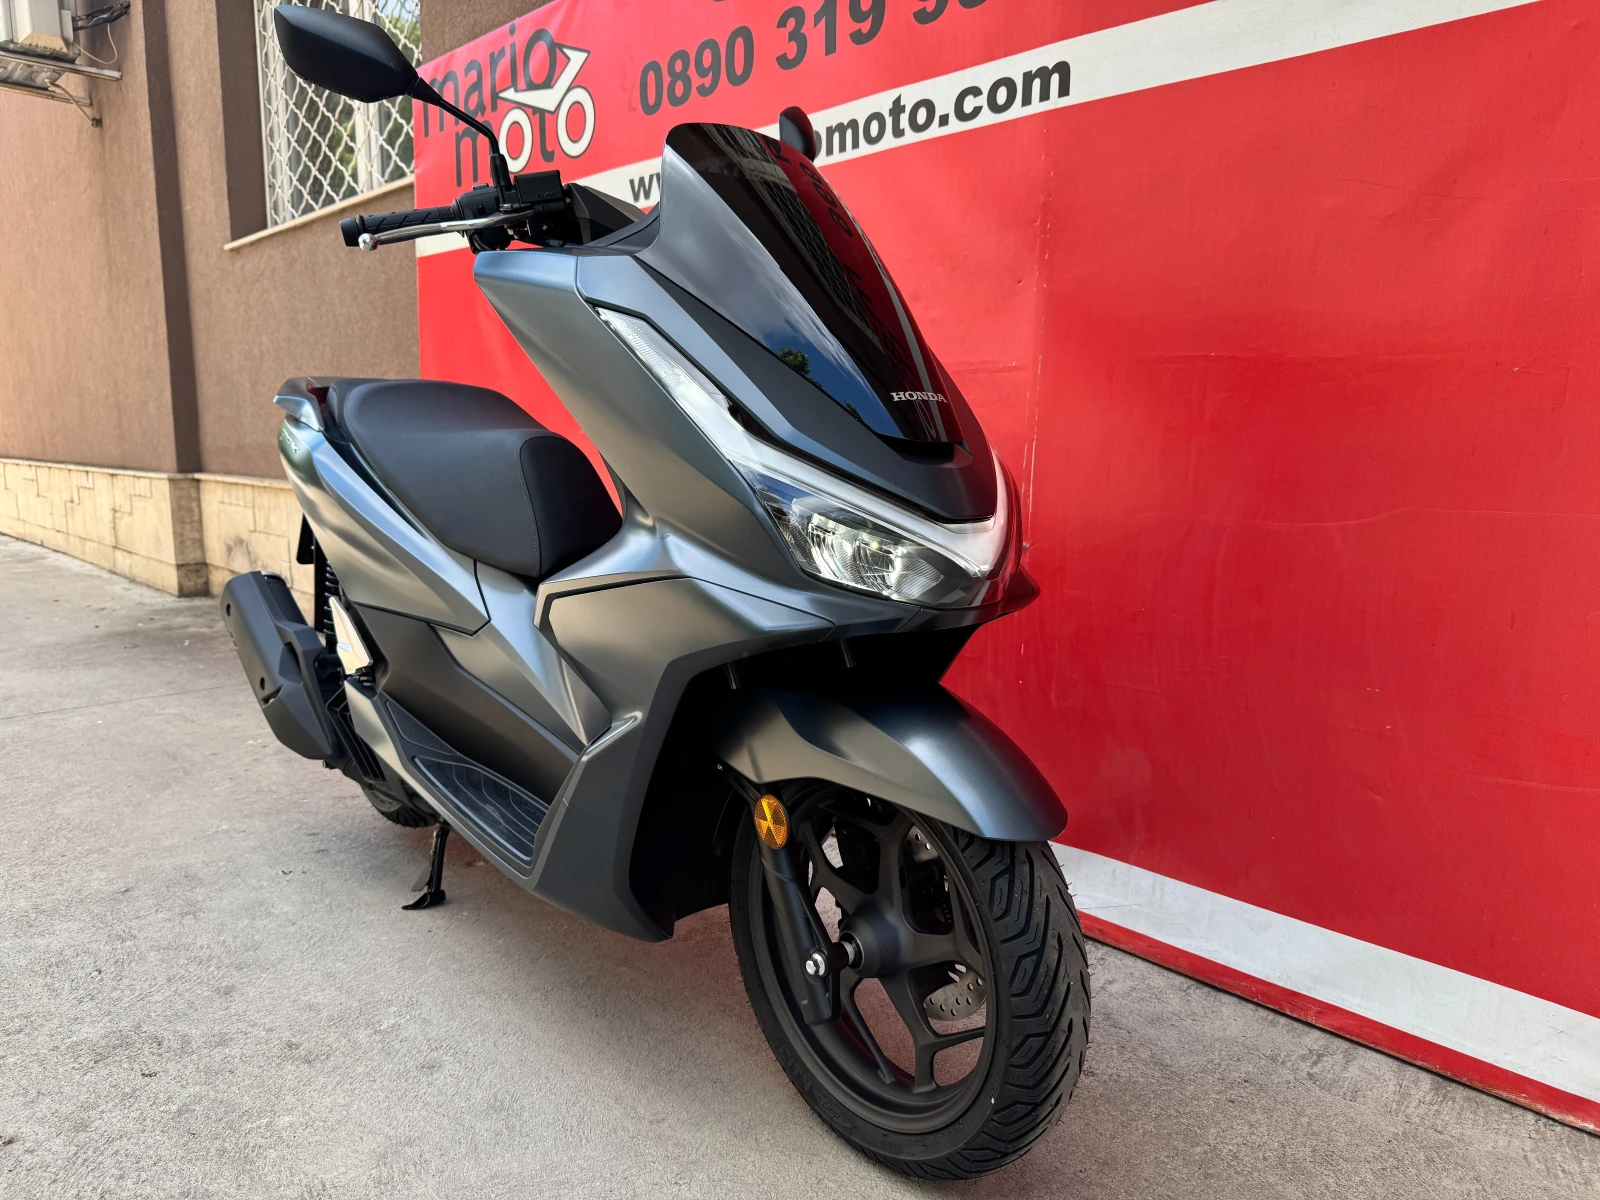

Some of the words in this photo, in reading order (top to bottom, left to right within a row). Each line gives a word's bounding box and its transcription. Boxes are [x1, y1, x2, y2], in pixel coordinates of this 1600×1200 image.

[422, 23, 557, 138] mario
[639, 25, 755, 116] 0890
[775, 0, 886, 71] 319
[455, 85, 596, 188] moto
[890, 391, 948, 403] HONDA
